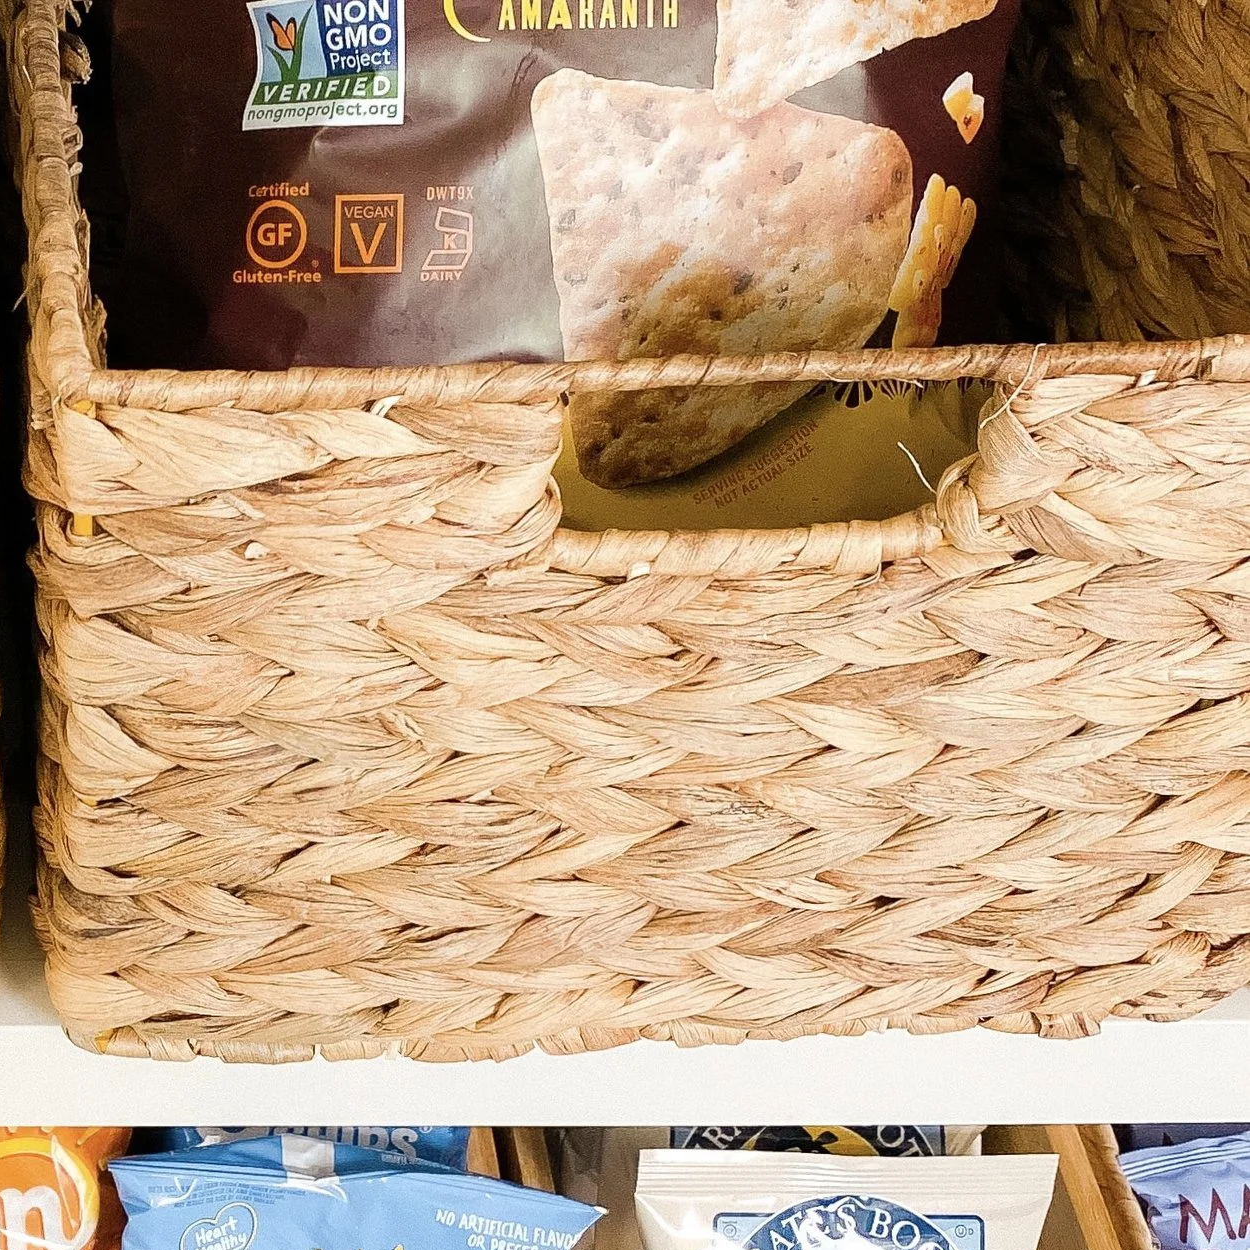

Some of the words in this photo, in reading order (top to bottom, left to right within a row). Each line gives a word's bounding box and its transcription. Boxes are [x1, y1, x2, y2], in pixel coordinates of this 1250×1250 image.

[323, 0, 391, 26] NON
[498, 0, 680, 31] AMARANTH
[326, 23, 393, 51] GMO
[329, 50, 392, 72] Project
[263, 75, 392, 103] VERIFIED
[247, 102, 398, 124] nongmoproject.org
[248, 182, 310, 198] Certified
[426, 186, 474, 201] DWT9X
[344, 205, 395, 219] VEGAN
[257, 223, 293, 247] GF
[232, 269, 322, 284] Gluten-Free
[419, 271, 464, 282] DAIRY
[742, 463, 787, 497] ACTUAL
[786, 441, 814, 467] SIZE
[693, 469, 746, 505] SERVING
[195, 1215, 238, 1246] Heart
[436, 1208, 456, 1228] NO
[459, 1213, 530, 1242] ARTIFICIAL
[467, 1234, 486, 1250] OR
